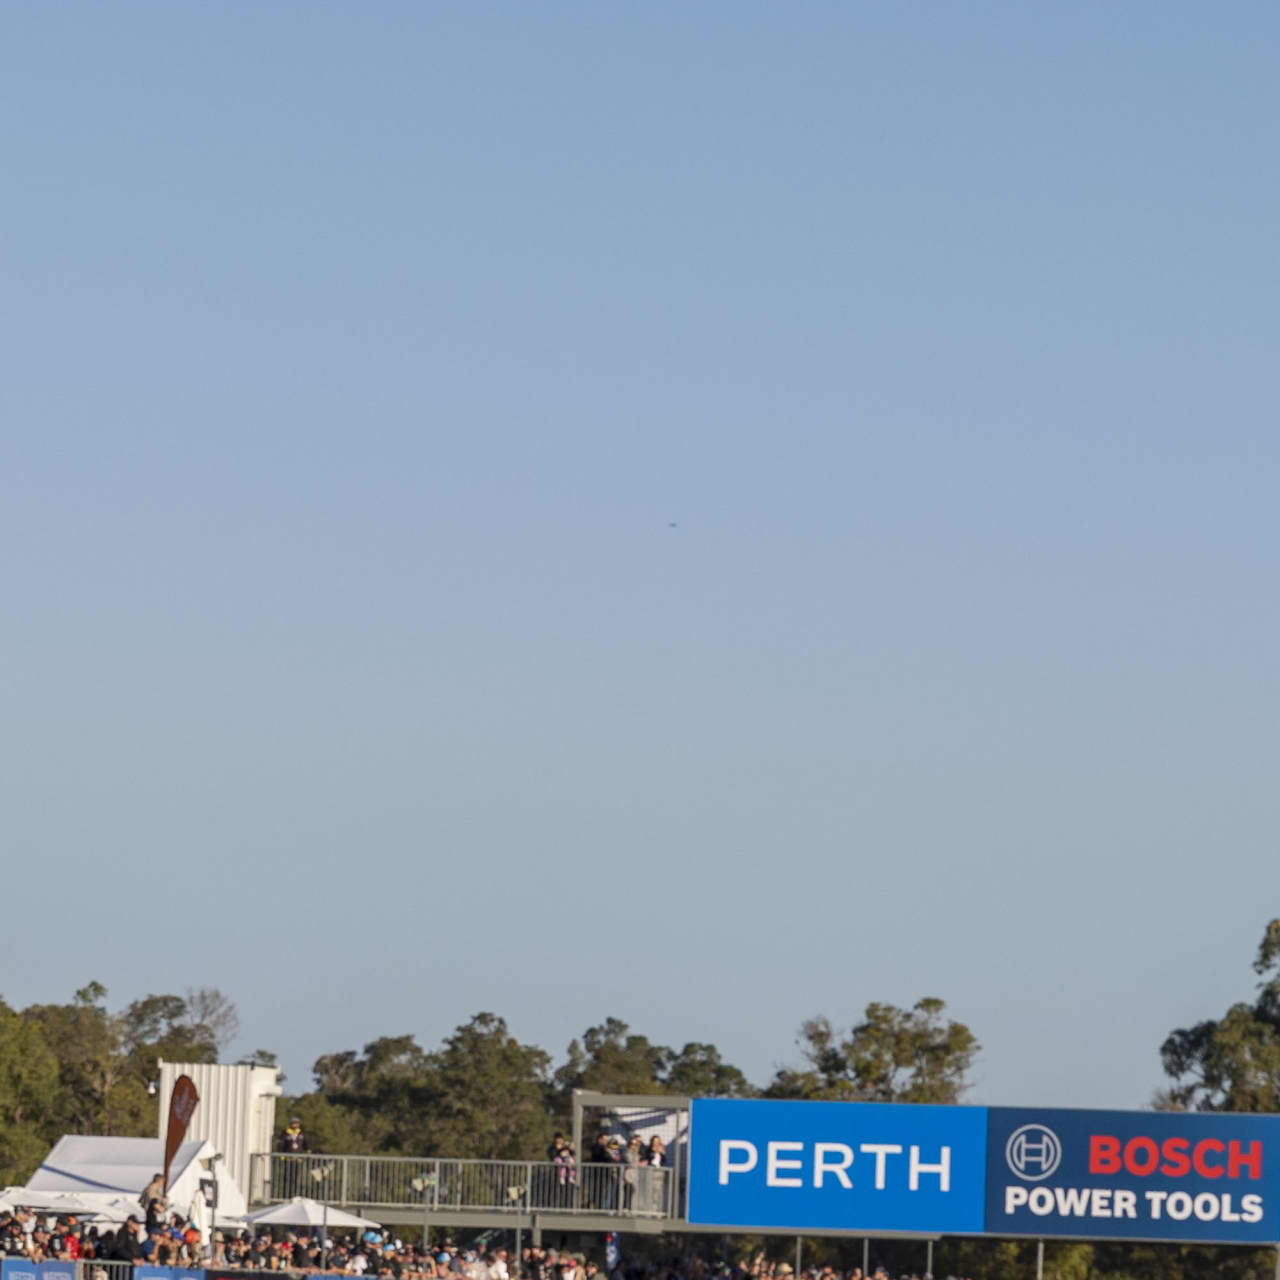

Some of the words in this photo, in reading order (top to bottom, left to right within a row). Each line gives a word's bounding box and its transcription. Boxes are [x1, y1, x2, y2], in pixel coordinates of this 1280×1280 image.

[720, 1139, 952, 1193] PERTH
[1087, 1134, 1263, 1180] BOSCH
[1004, 1185, 1138, 1219] POWER
[1145, 1189, 1264, 1223] TOOLS
